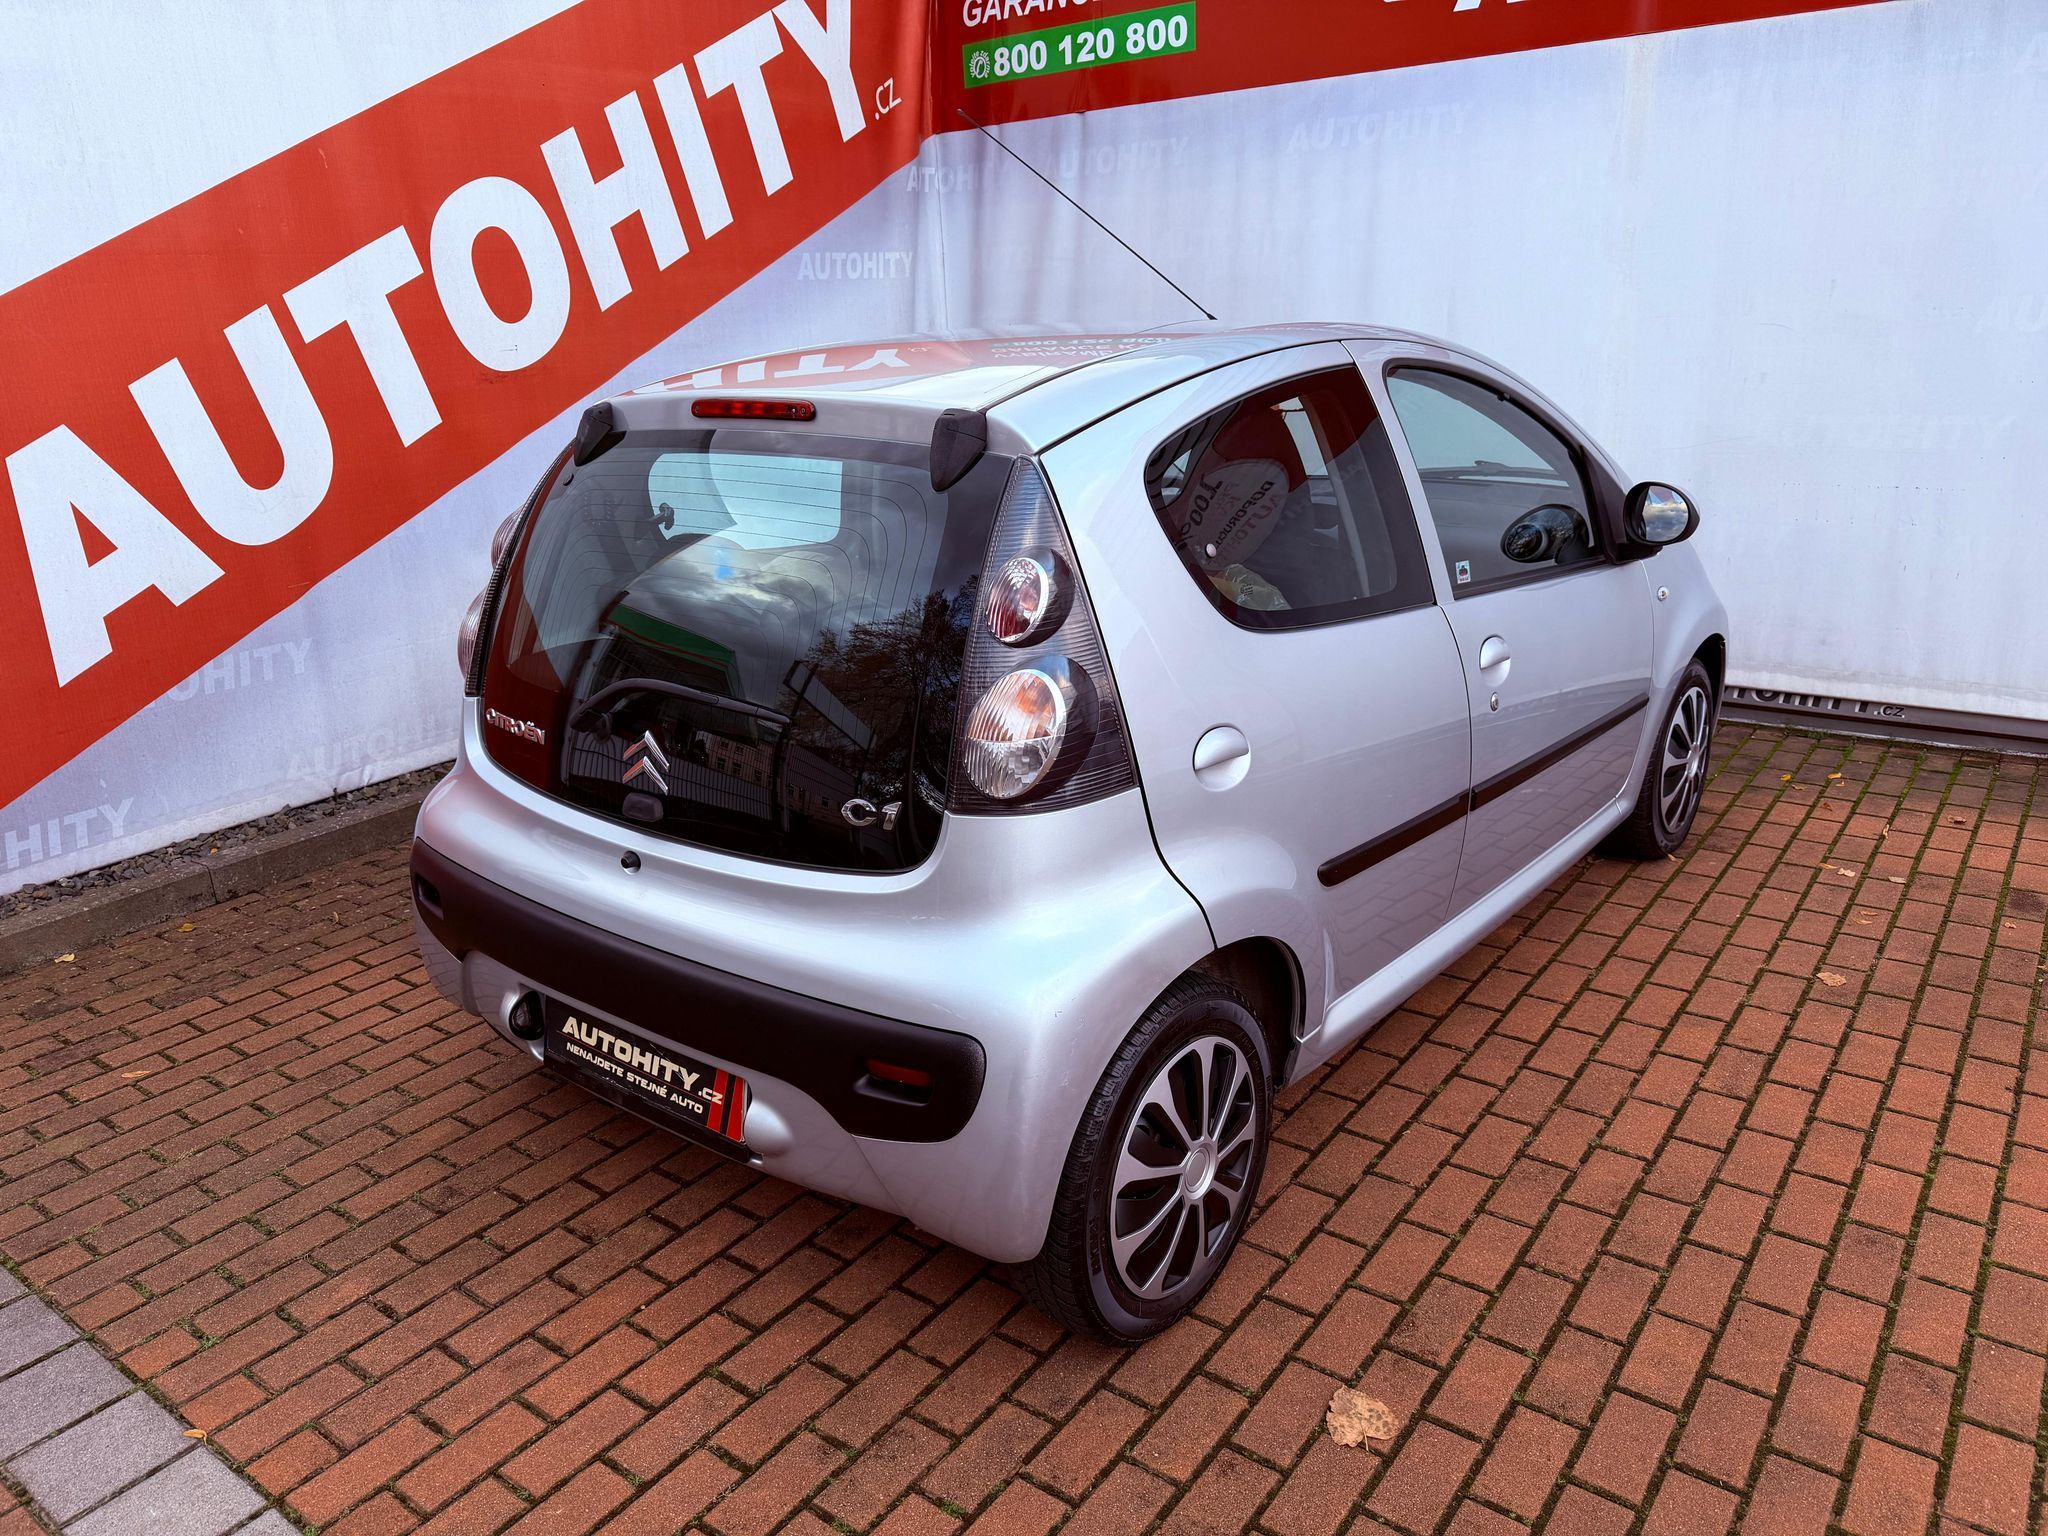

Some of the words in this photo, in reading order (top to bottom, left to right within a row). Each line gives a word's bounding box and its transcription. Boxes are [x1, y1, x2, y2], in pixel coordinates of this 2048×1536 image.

[994, 40, 1047, 76] 800
[1059, 28, 1115, 65] 120
[1126, 15, 1188, 54] 800
[797, 250, 914, 281] AUTOHITY
[486, 708, 545, 745] CITROËN
[841, 799, 902, 831] C1
[566, 1042, 623, 1078] NENAJDETE
[626, 1072, 667, 1098] STEJNÉ
[670, 1093, 703, 1114] AUTO
